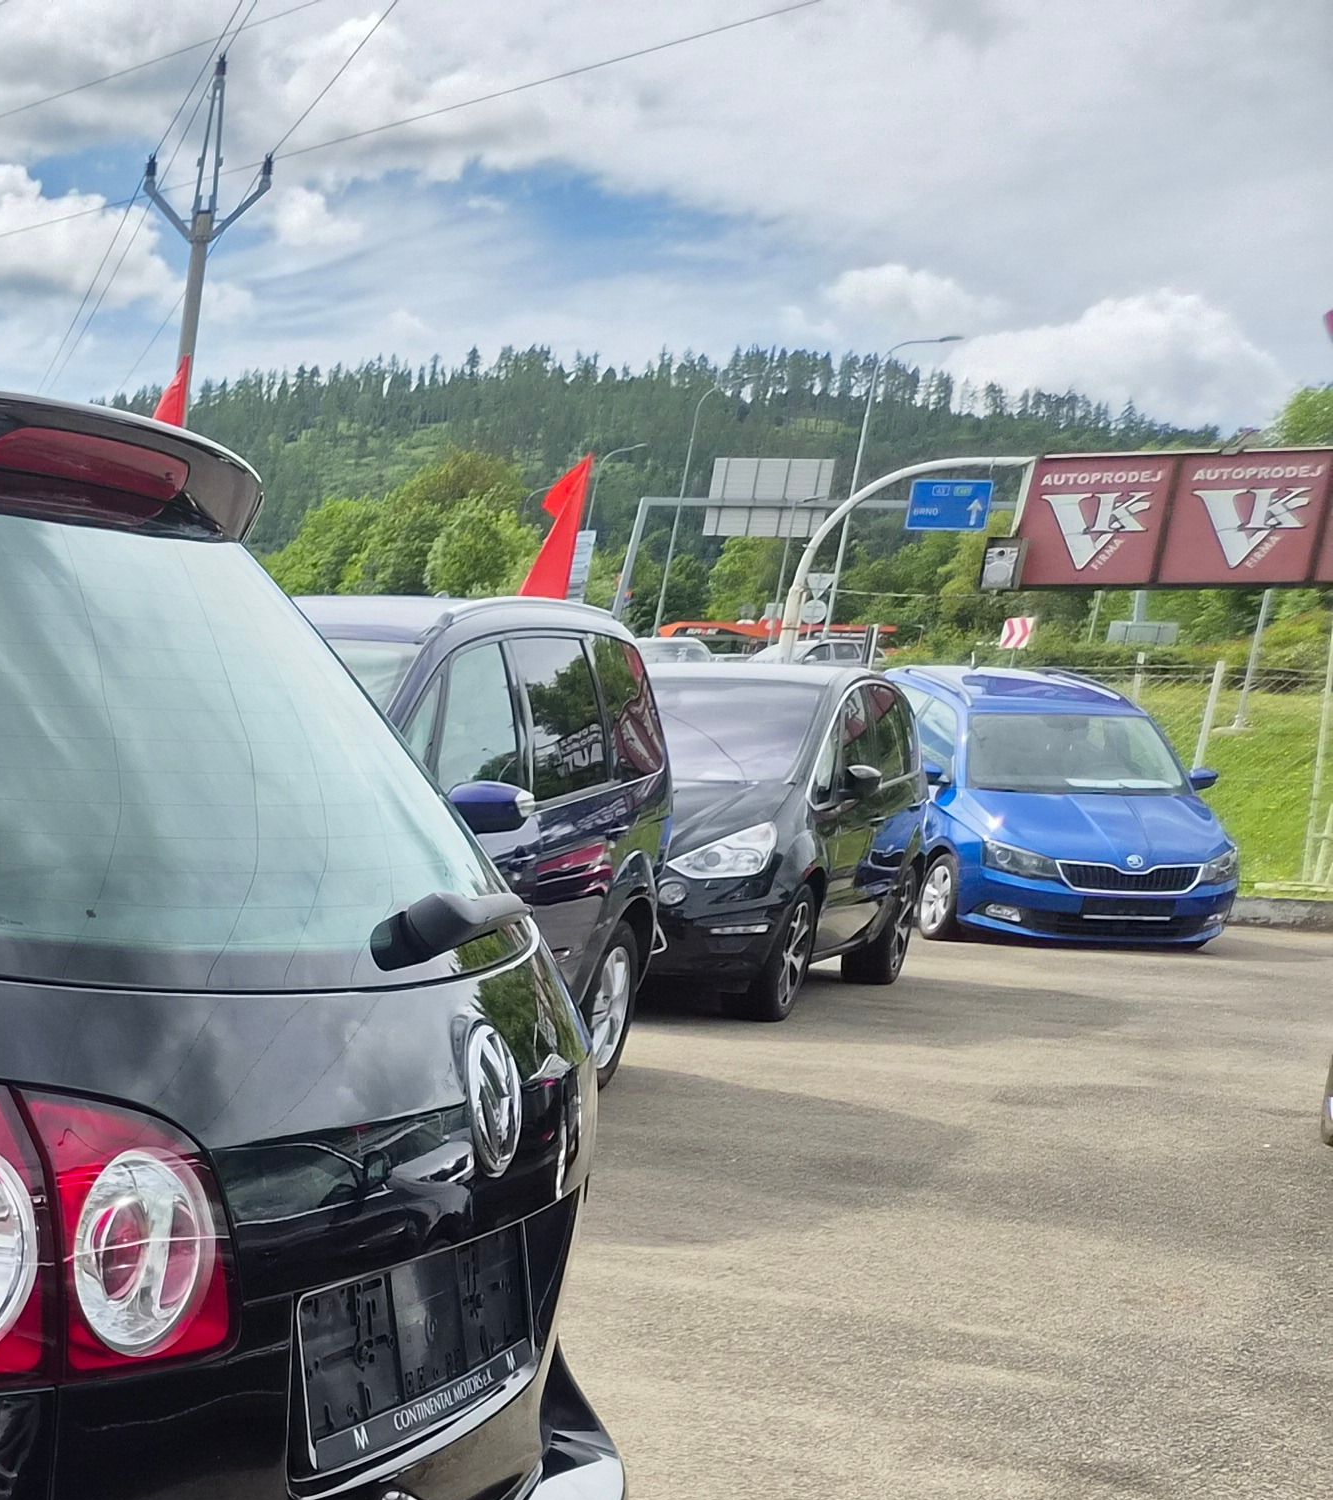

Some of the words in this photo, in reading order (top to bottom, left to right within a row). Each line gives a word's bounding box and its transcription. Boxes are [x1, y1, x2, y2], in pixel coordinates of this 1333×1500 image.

[1040, 470, 1164, 488] AUTOPRODEJ
[1191, 463, 1325, 482] AUTOPRODEJ
[1089, 536, 1126, 571] FIRMA
[1244, 533, 1284, 569] FIRMA
[393, 1389, 455, 1431] CONTINENTAL
[452, 1372, 484, 1404] MOTORS
